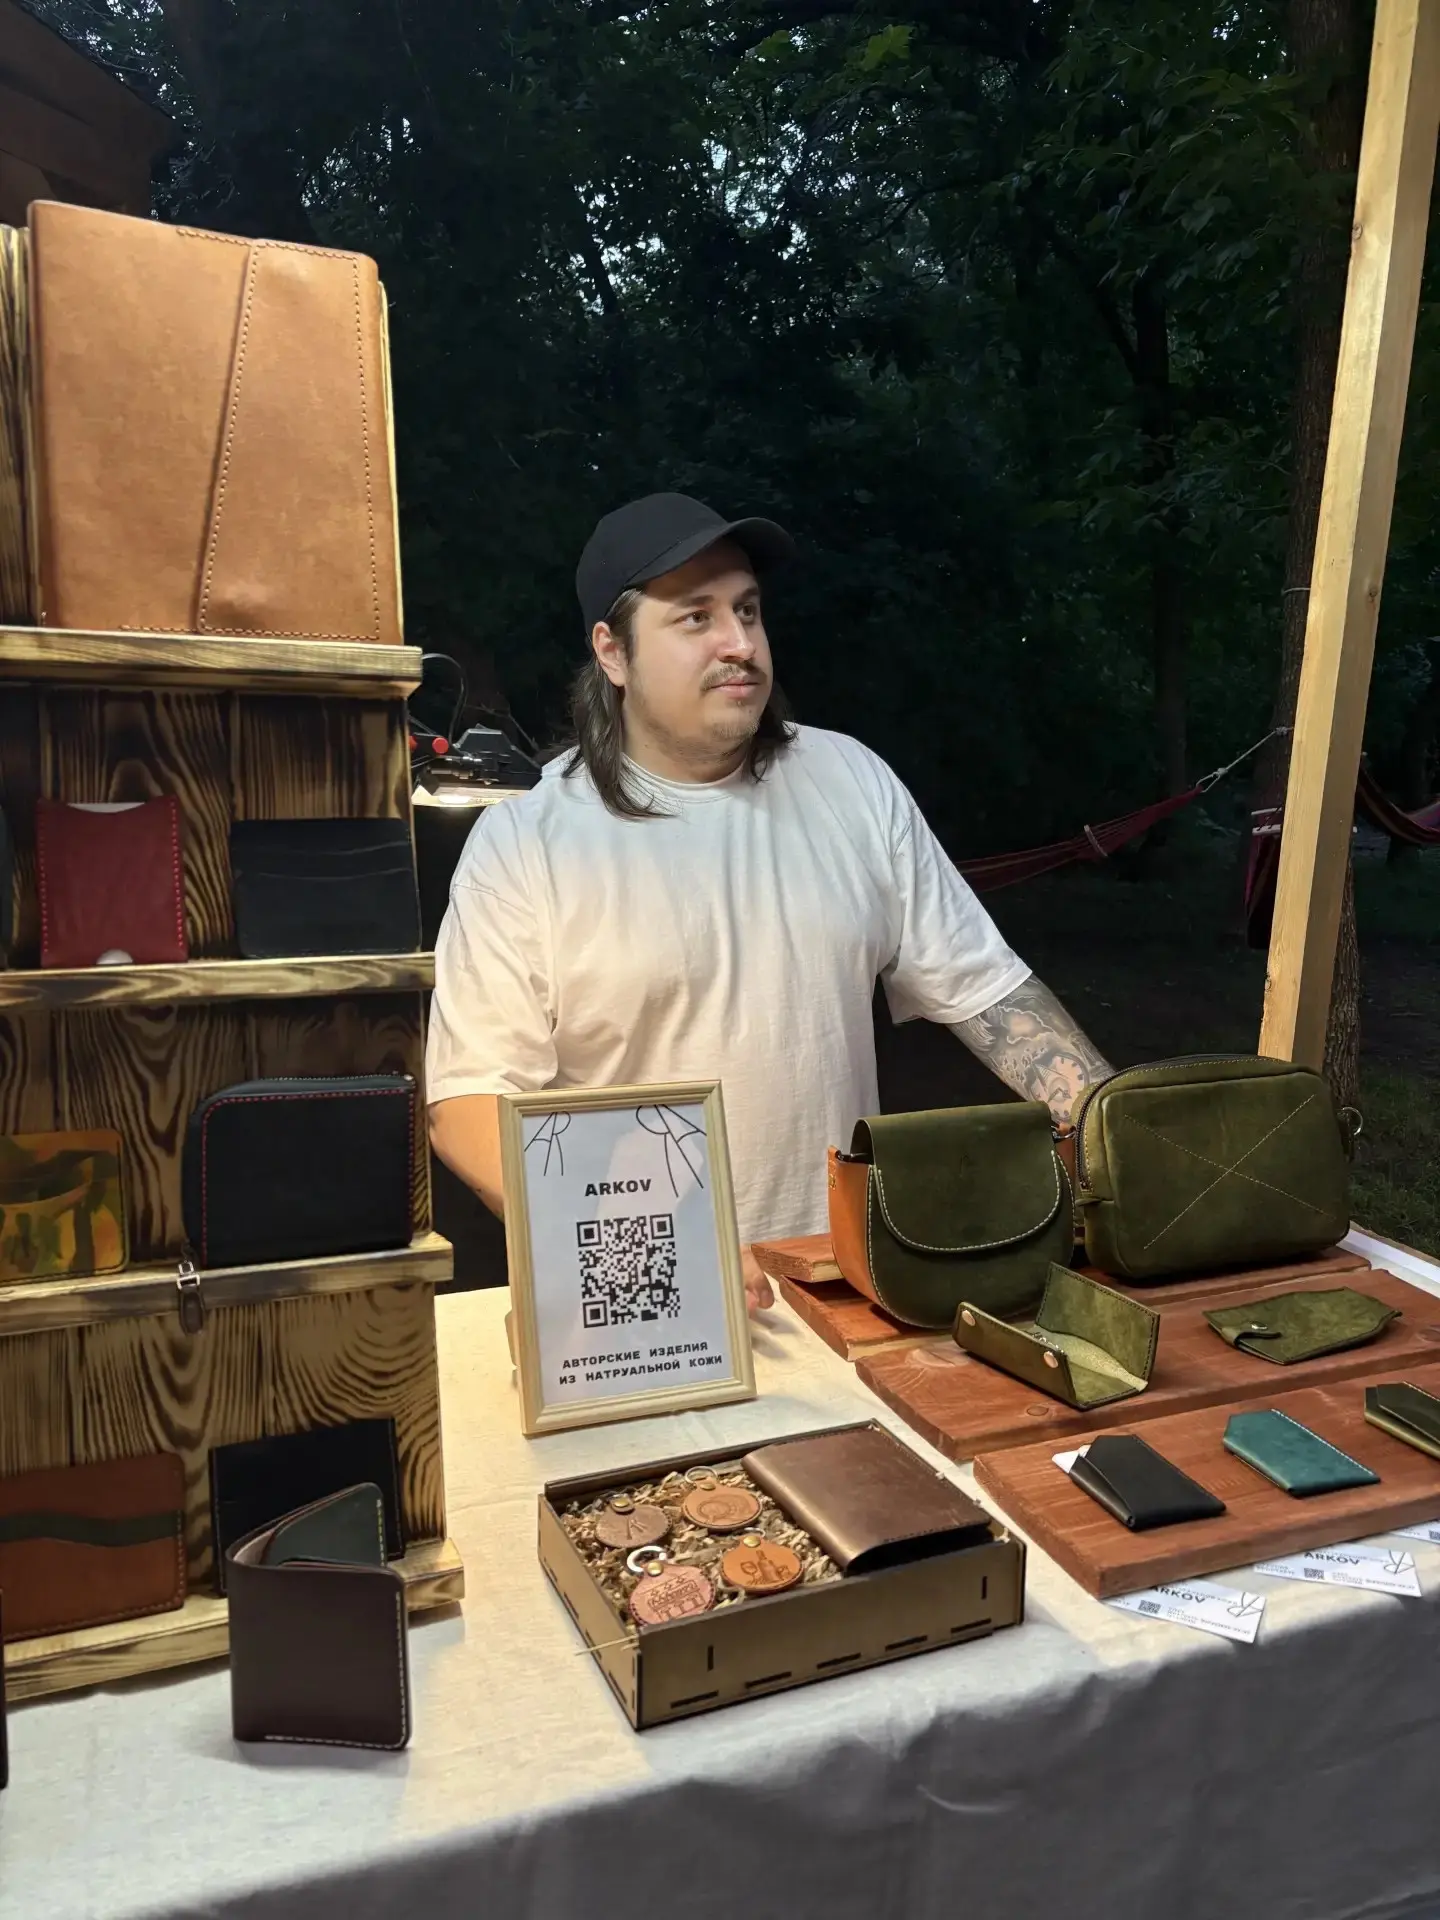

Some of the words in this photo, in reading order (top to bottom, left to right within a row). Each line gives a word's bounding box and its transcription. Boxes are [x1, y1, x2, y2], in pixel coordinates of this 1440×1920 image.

[584, 1178, 652, 1197] ARKOV
[562, 1351, 641, 1369] АВТОРСКИЕ
[649, 1341, 708, 1357] ИЗДЕЛИЯ
[559, 1375, 576, 1385] ИЗ
[585, 1359, 680, 1382] НАТРУАЛЬНОЙ
[689, 1354, 723, 1368] КОЖИ
[1303, 1551, 1360, 1565] ARKOV
